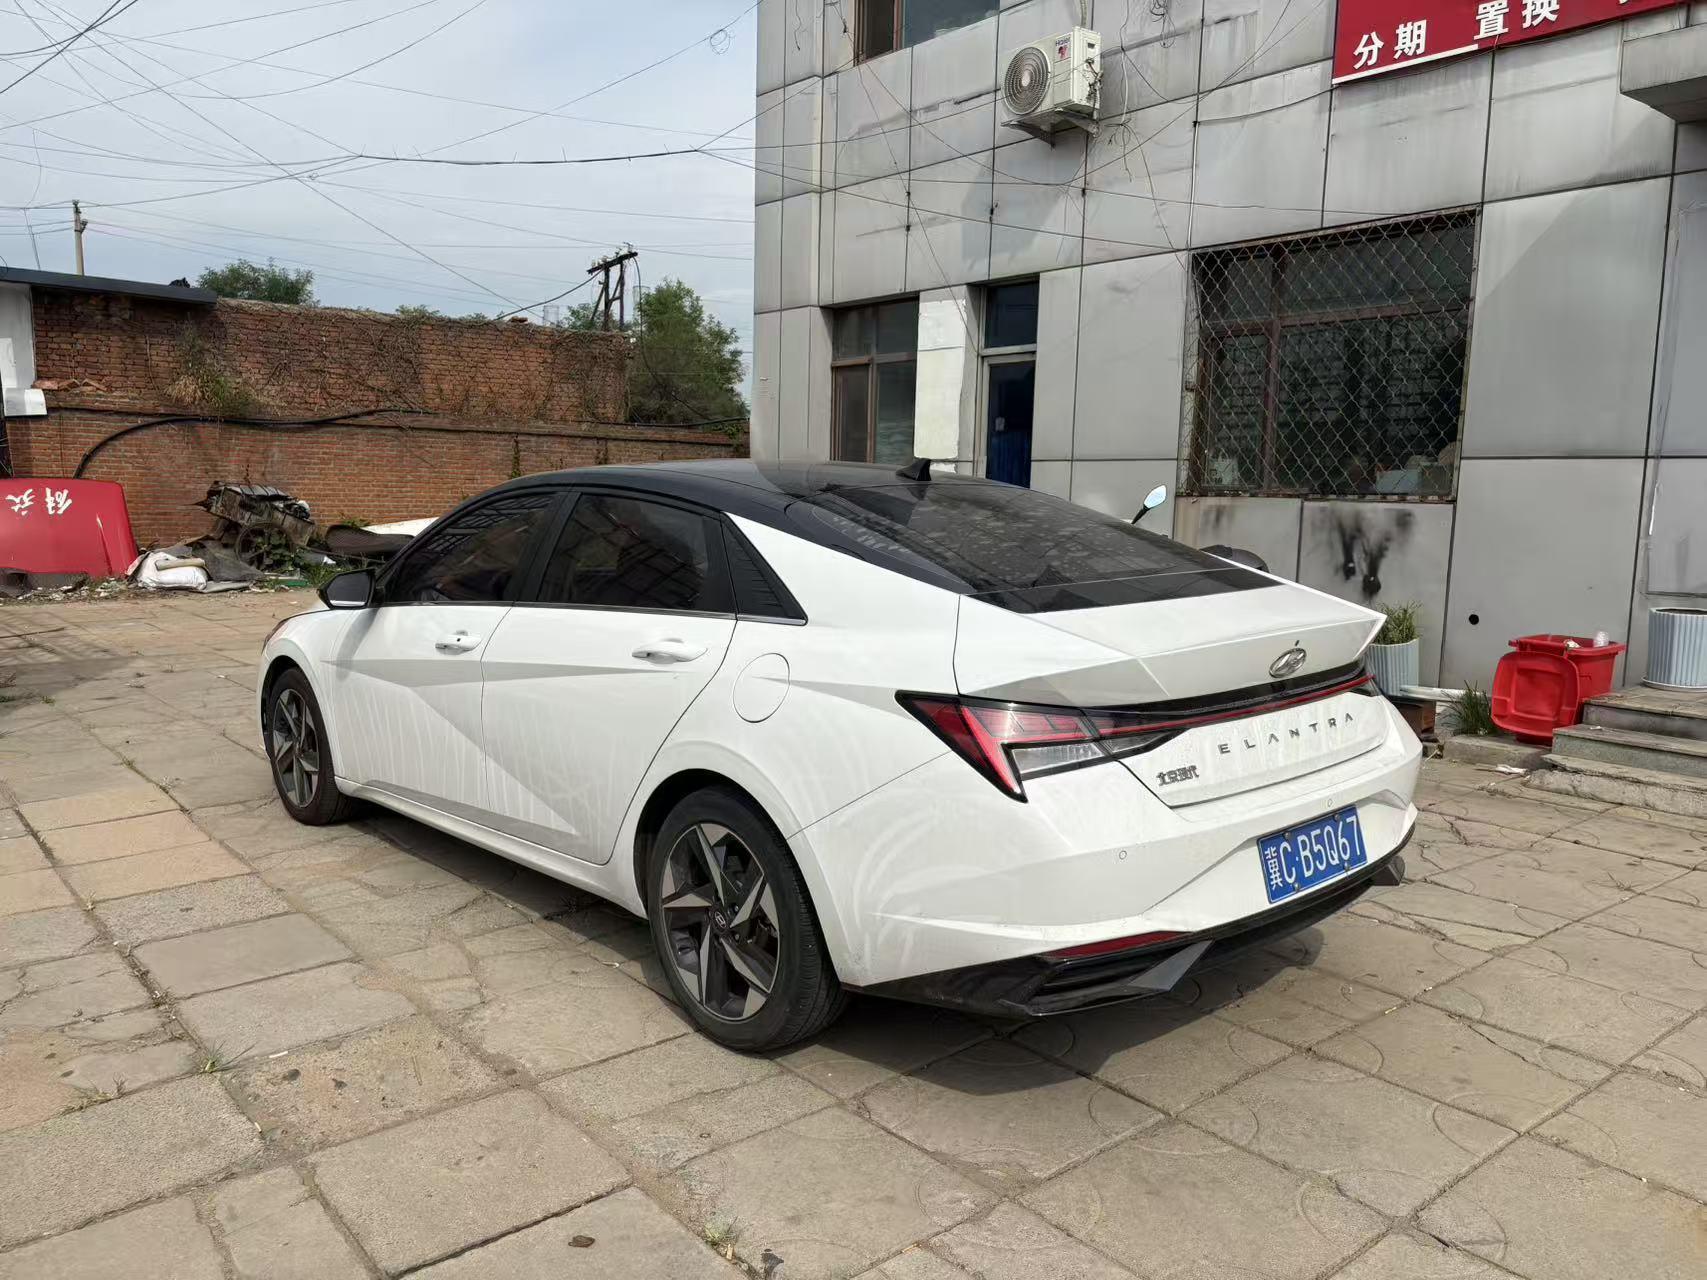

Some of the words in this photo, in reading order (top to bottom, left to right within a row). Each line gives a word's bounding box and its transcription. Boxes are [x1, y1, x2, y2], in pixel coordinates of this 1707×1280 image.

[1353, 19, 1428, 69] 分期
[1474, 0, 1560, 41] 置换
[1217, 712, 1354, 755] ELANTRA
[1156, 764, 1200, 787] 北京现代
